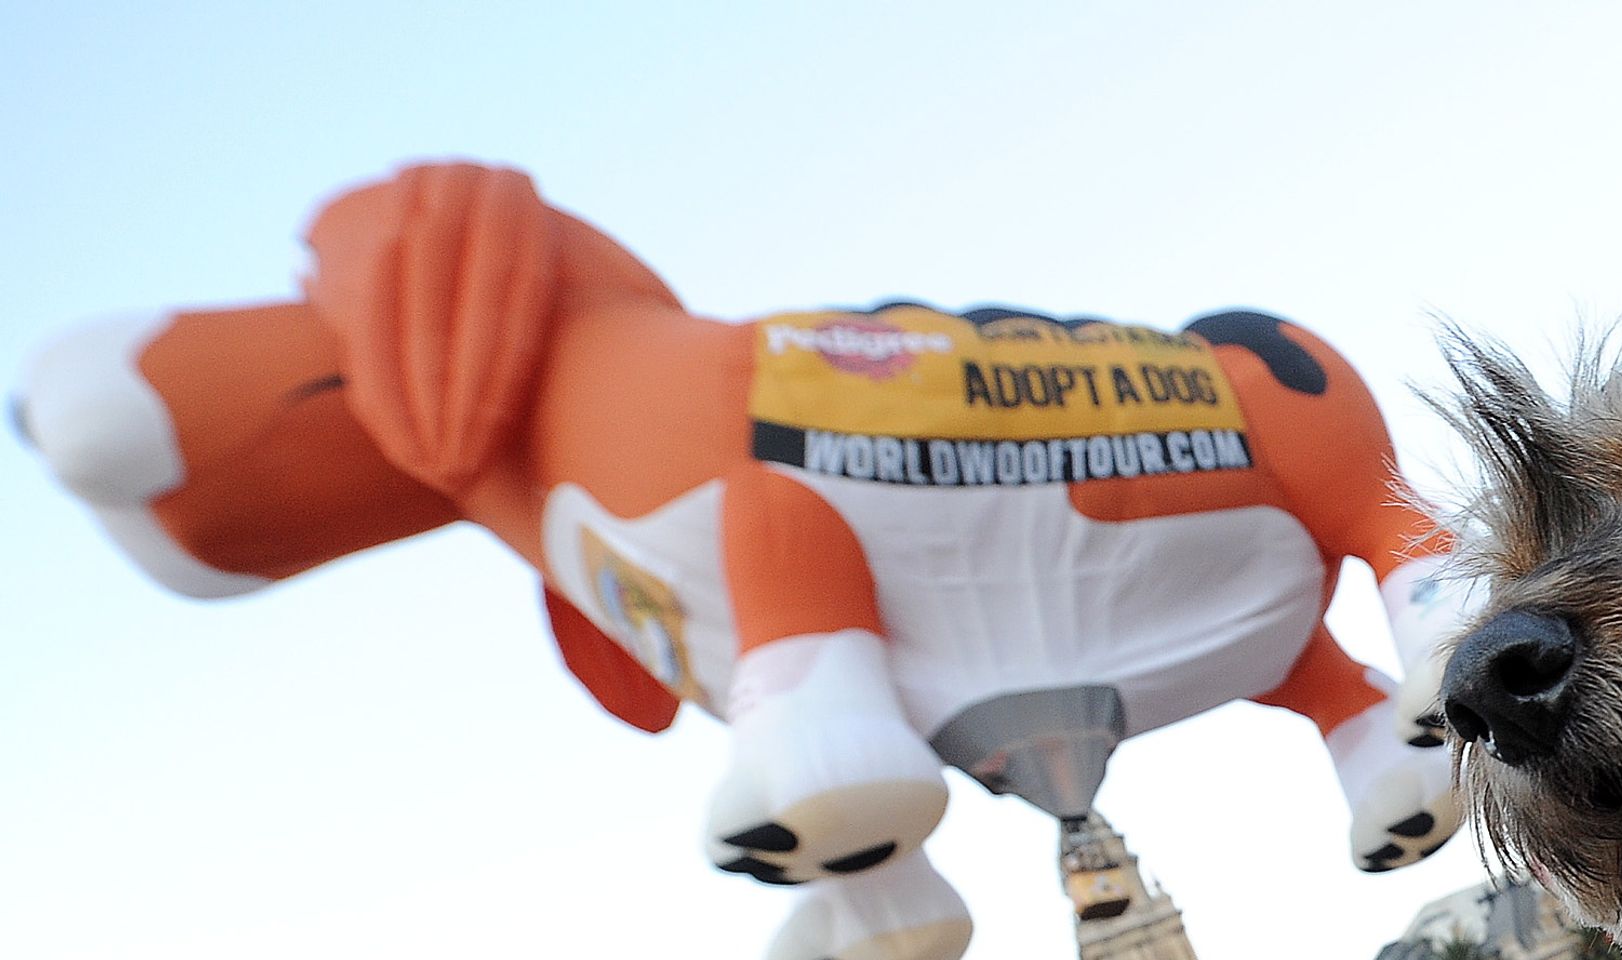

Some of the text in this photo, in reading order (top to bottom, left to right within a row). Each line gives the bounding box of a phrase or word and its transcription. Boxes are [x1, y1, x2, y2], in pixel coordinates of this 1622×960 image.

[963, 361, 1218, 408] ADOPT A DOG
[804, 428, 1251, 485] WORLDWOOFTOUR.COM
